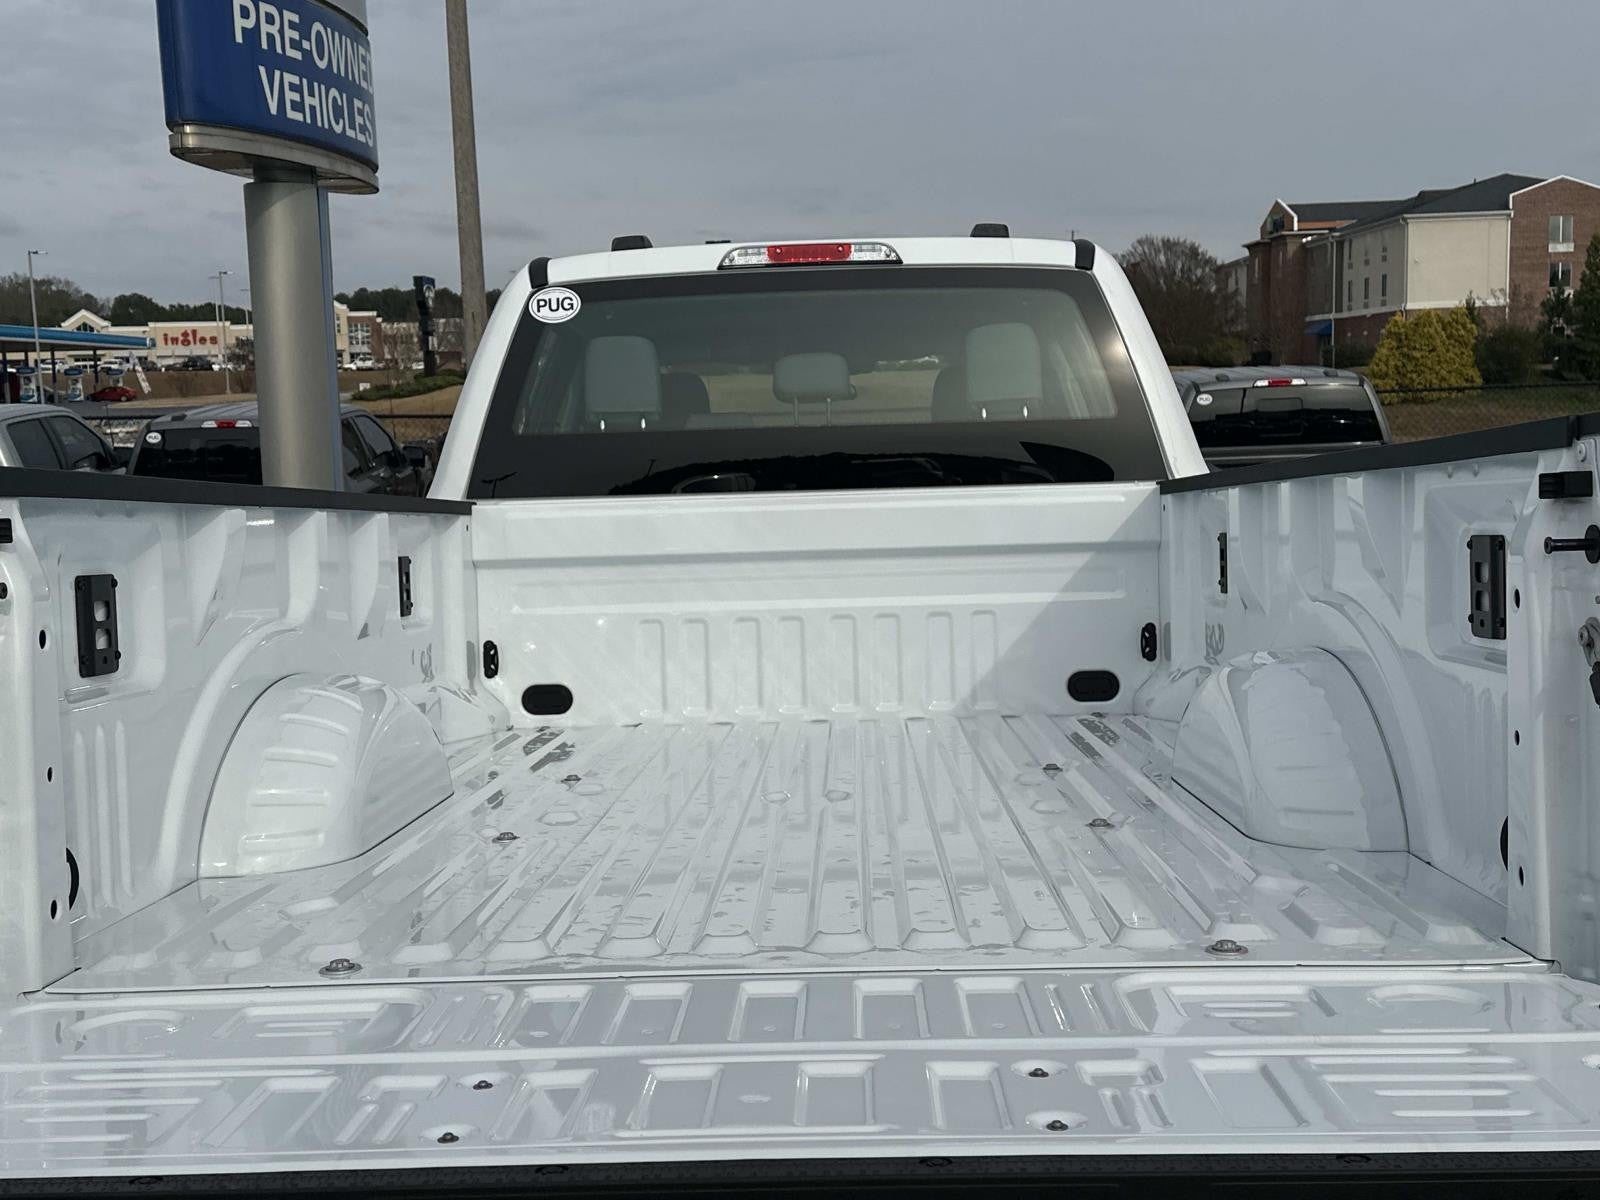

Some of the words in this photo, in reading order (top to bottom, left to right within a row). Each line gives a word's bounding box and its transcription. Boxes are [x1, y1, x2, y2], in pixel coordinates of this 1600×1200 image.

[258, 65, 373, 148] VEHICLES
[536, 296, 574, 313] PUG
[163, 328, 218, 346] ingles
